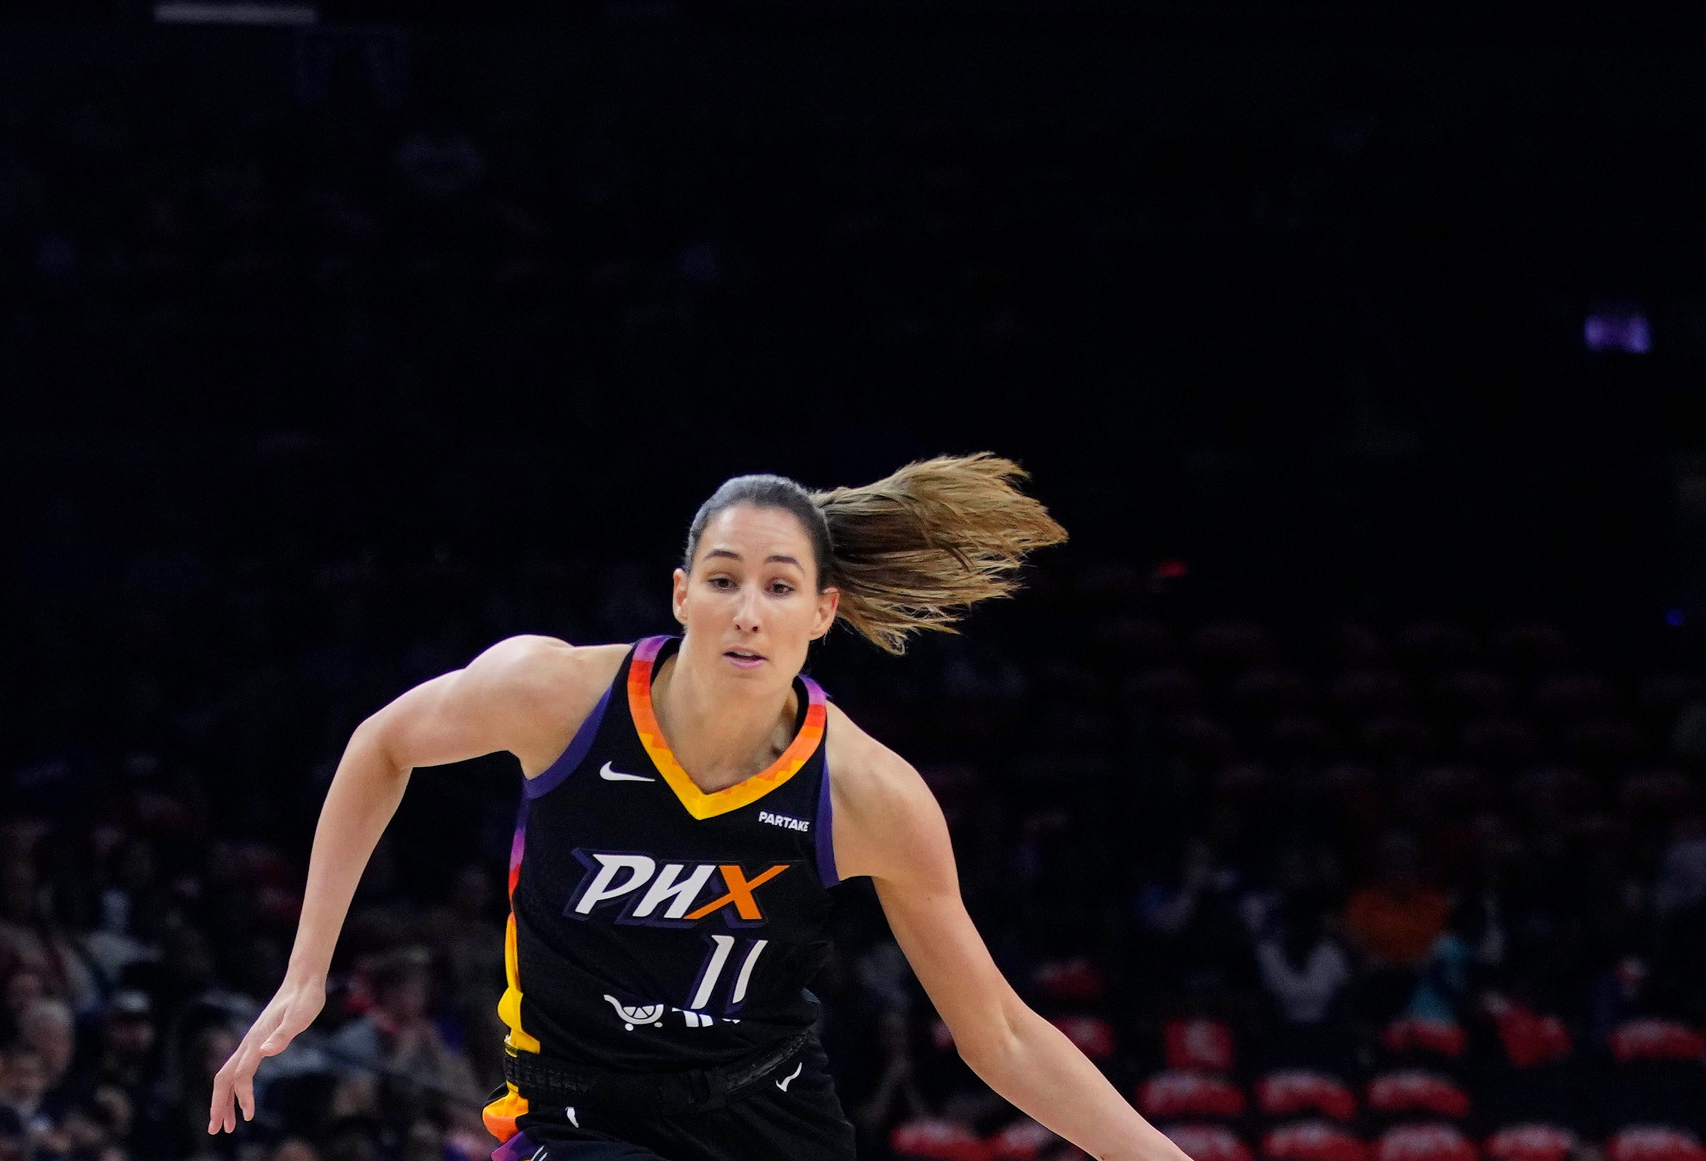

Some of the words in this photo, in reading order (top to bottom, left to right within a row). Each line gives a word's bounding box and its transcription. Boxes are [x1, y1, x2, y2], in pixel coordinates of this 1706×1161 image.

[758, 811, 810, 832] PARTAKE
[573, 853, 791, 920] PHX
[690, 934, 769, 1010] 11
